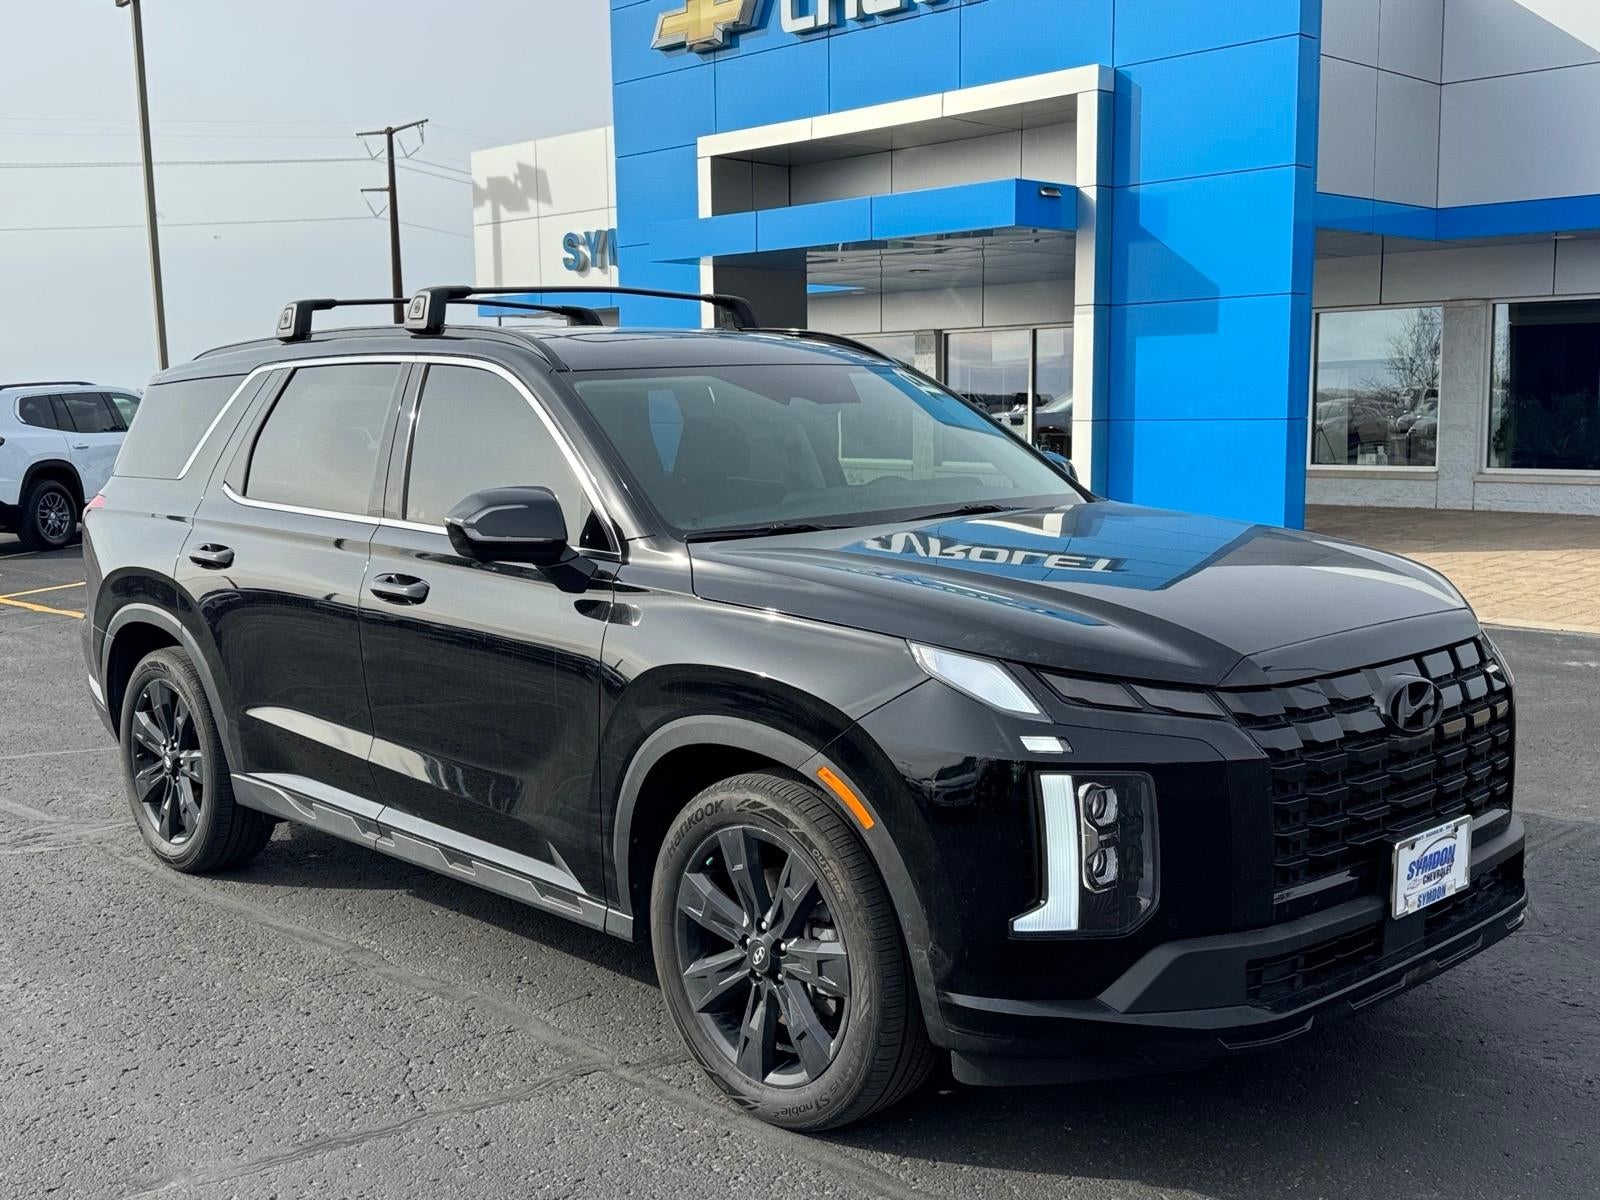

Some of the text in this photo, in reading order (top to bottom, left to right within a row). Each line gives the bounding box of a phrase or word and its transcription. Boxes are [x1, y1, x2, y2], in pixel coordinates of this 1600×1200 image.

[1407, 843, 1456, 880] SYMDON
[1422, 864, 1452, 885] CHEVROLET
[1417, 884, 1447, 908] SYMDON
